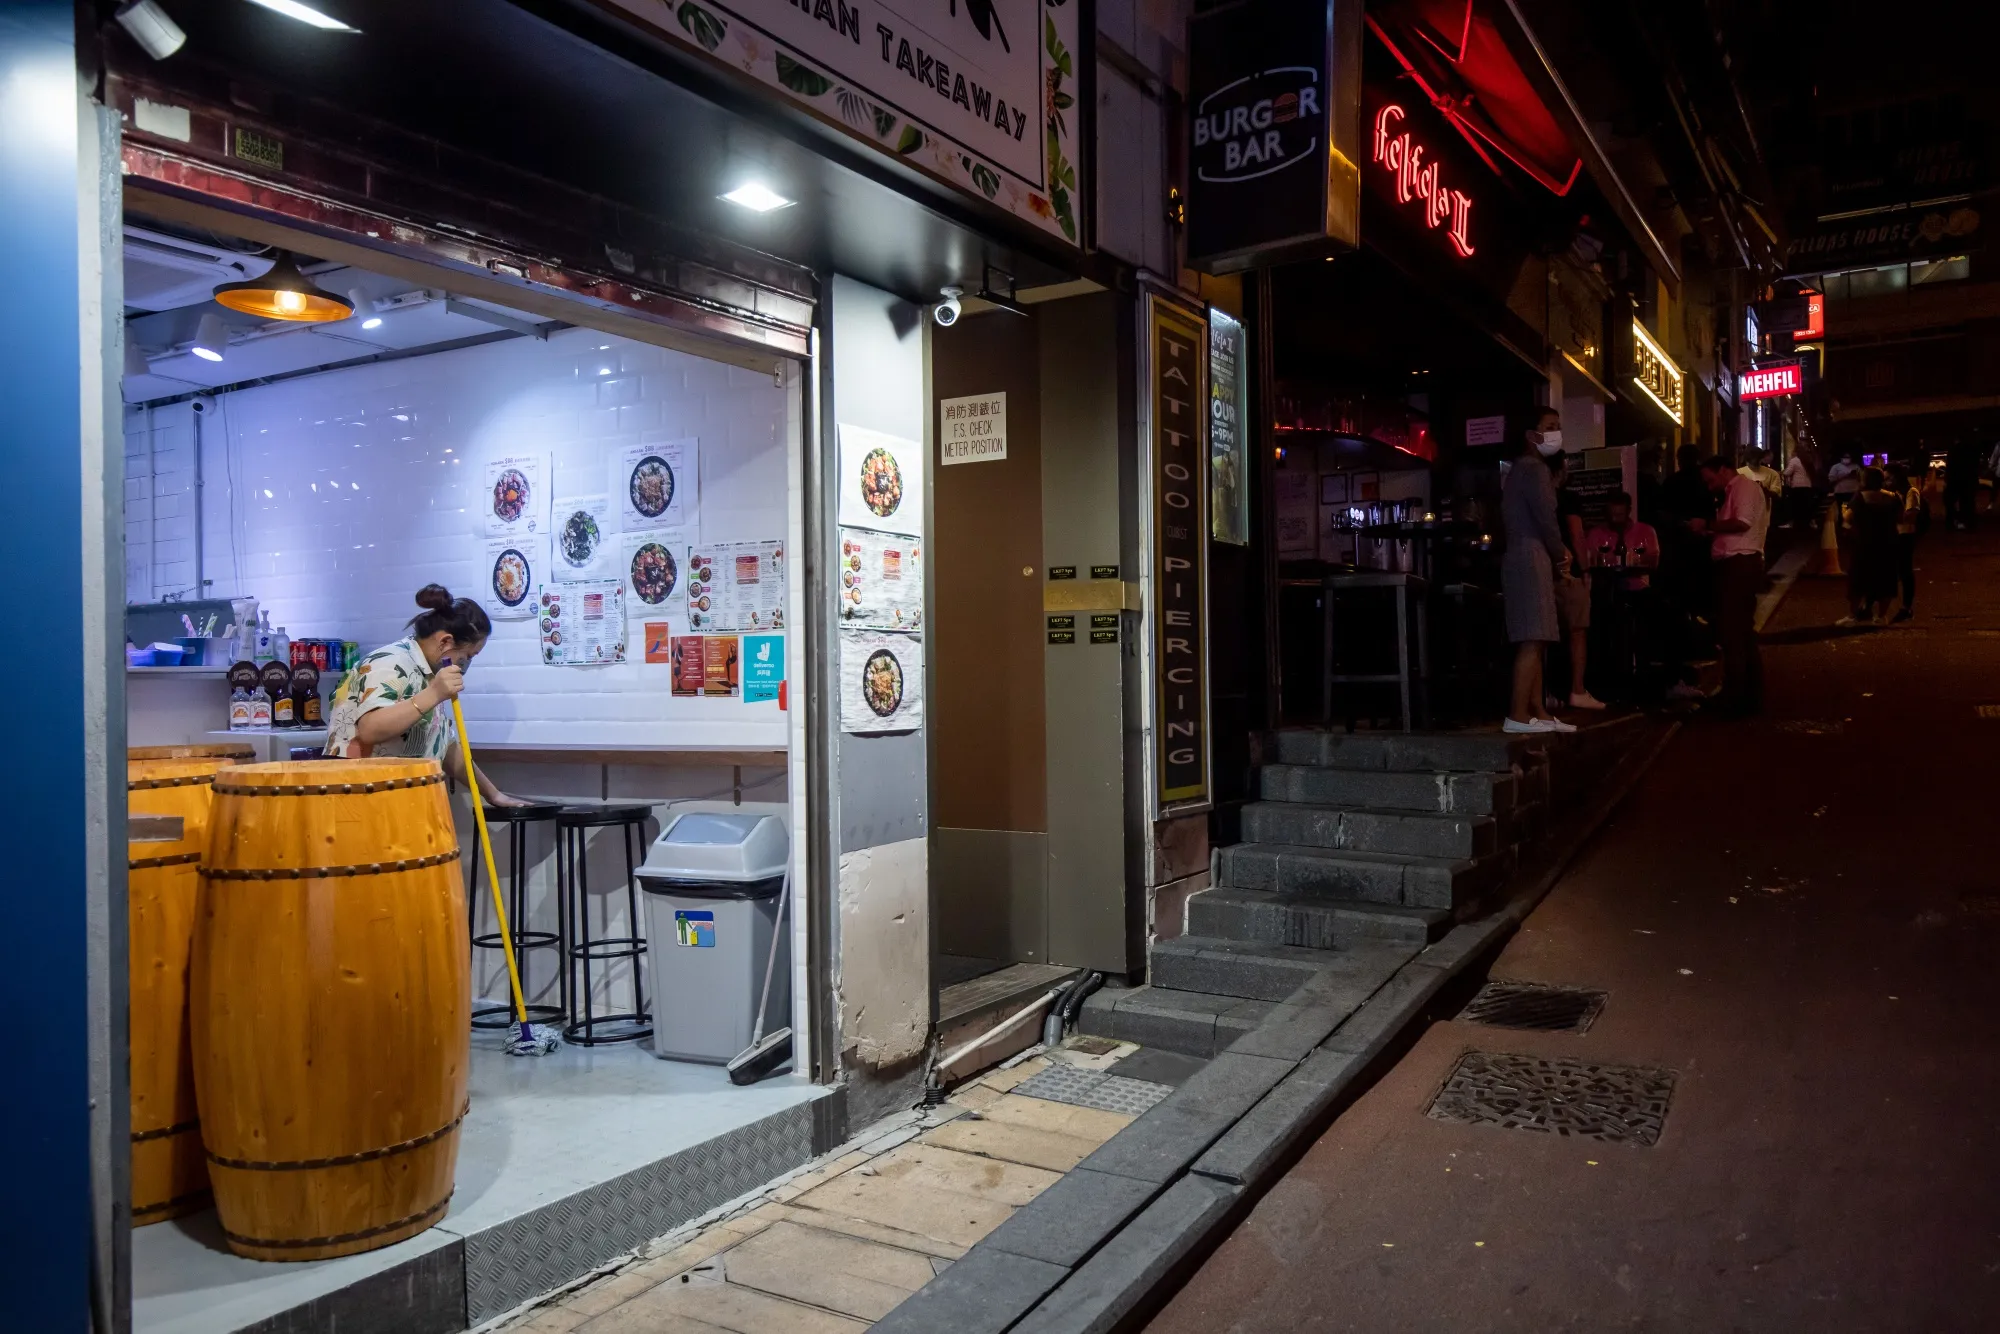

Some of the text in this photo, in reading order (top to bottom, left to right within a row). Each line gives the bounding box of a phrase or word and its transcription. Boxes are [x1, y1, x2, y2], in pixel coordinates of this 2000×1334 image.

[877, 22, 1028, 142] TAKEAWAY
[1224, 130, 1285, 172] BAR
[1212, 382, 1234, 403] APPY
[1740, 369, 1797, 396] MEHFIL
[953, 420, 993, 438] F.S. CHECK
[1162, 336, 1190, 509] TATTOO
[944, 437, 1003, 458] METER POSITION
[1164, 556, 1195, 765] PIERCING
